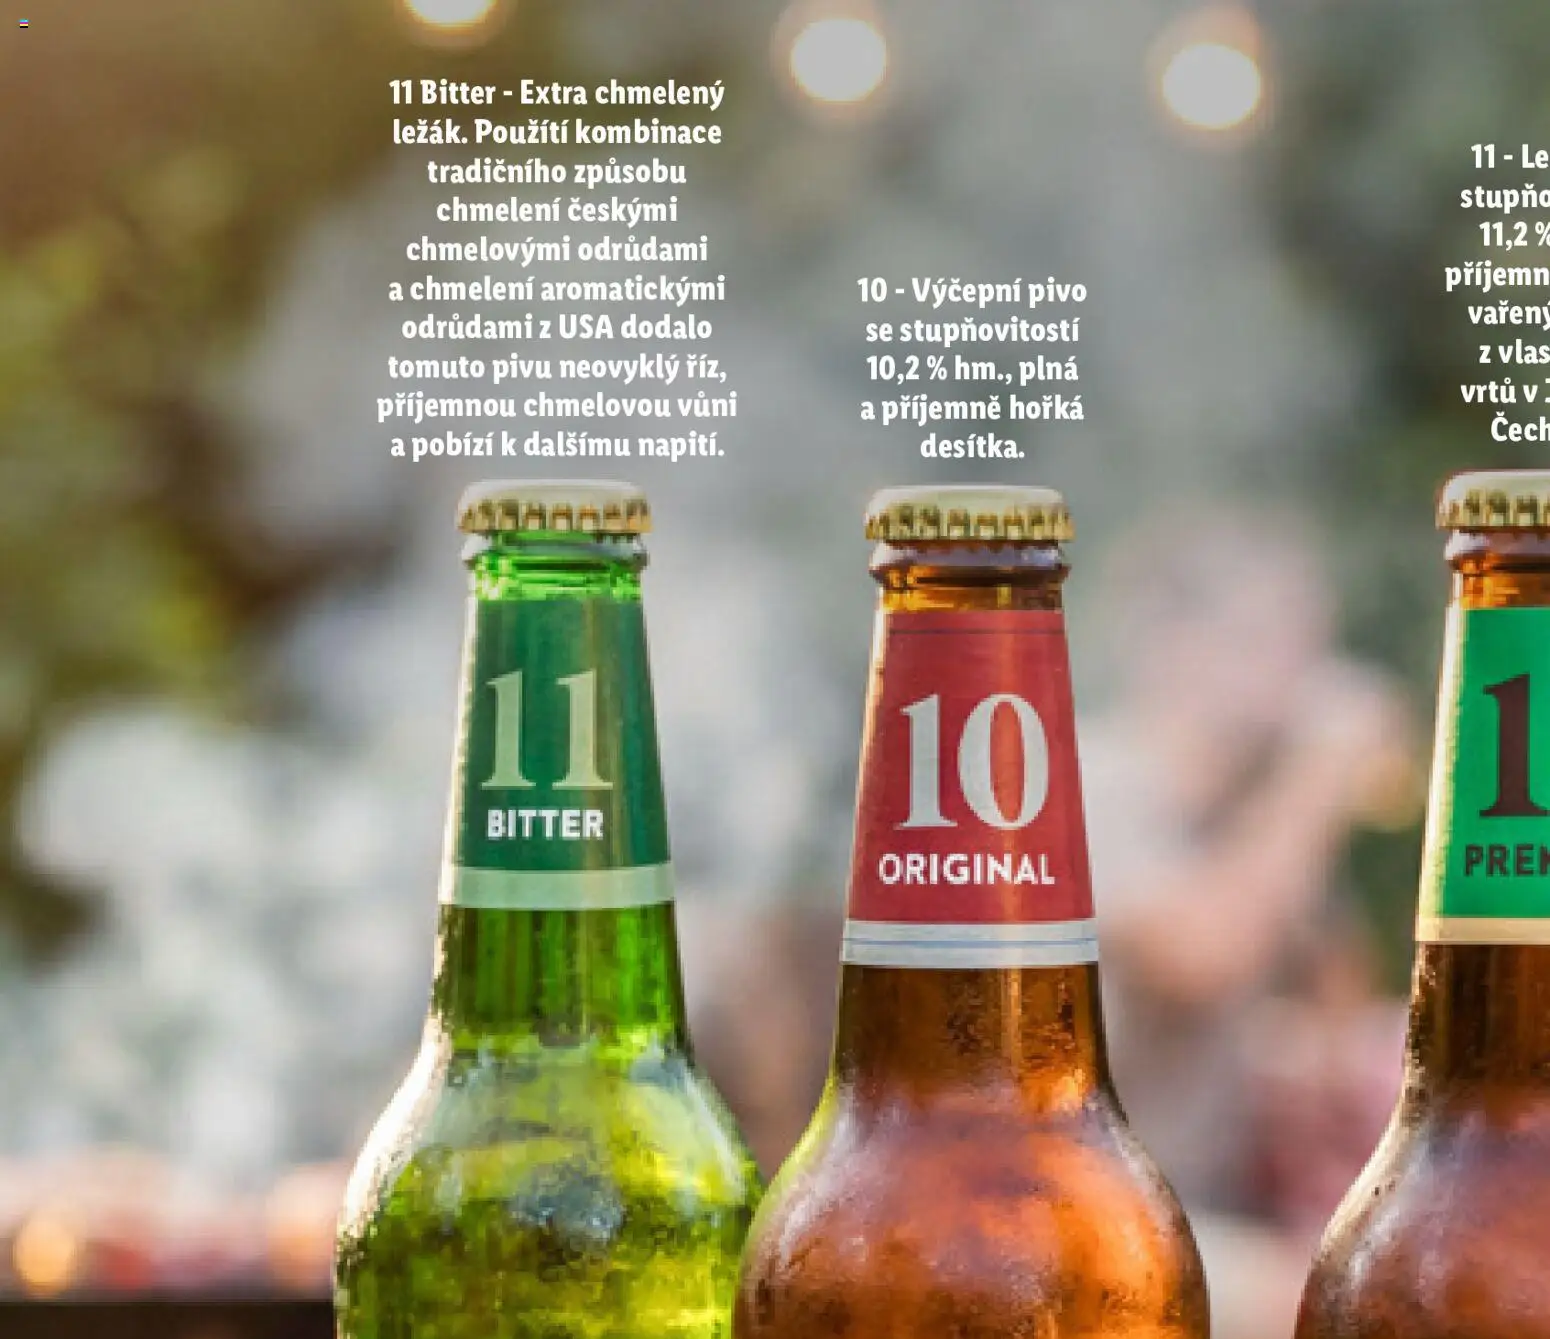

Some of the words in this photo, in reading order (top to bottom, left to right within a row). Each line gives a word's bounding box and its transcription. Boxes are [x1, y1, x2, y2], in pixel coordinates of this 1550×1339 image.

[481, 670, 613, 790] 11
[894, 693, 1049, 831] 10
[487, 809, 604, 841] BITTER
[878, 853, 1056, 886] ORIGINAL
